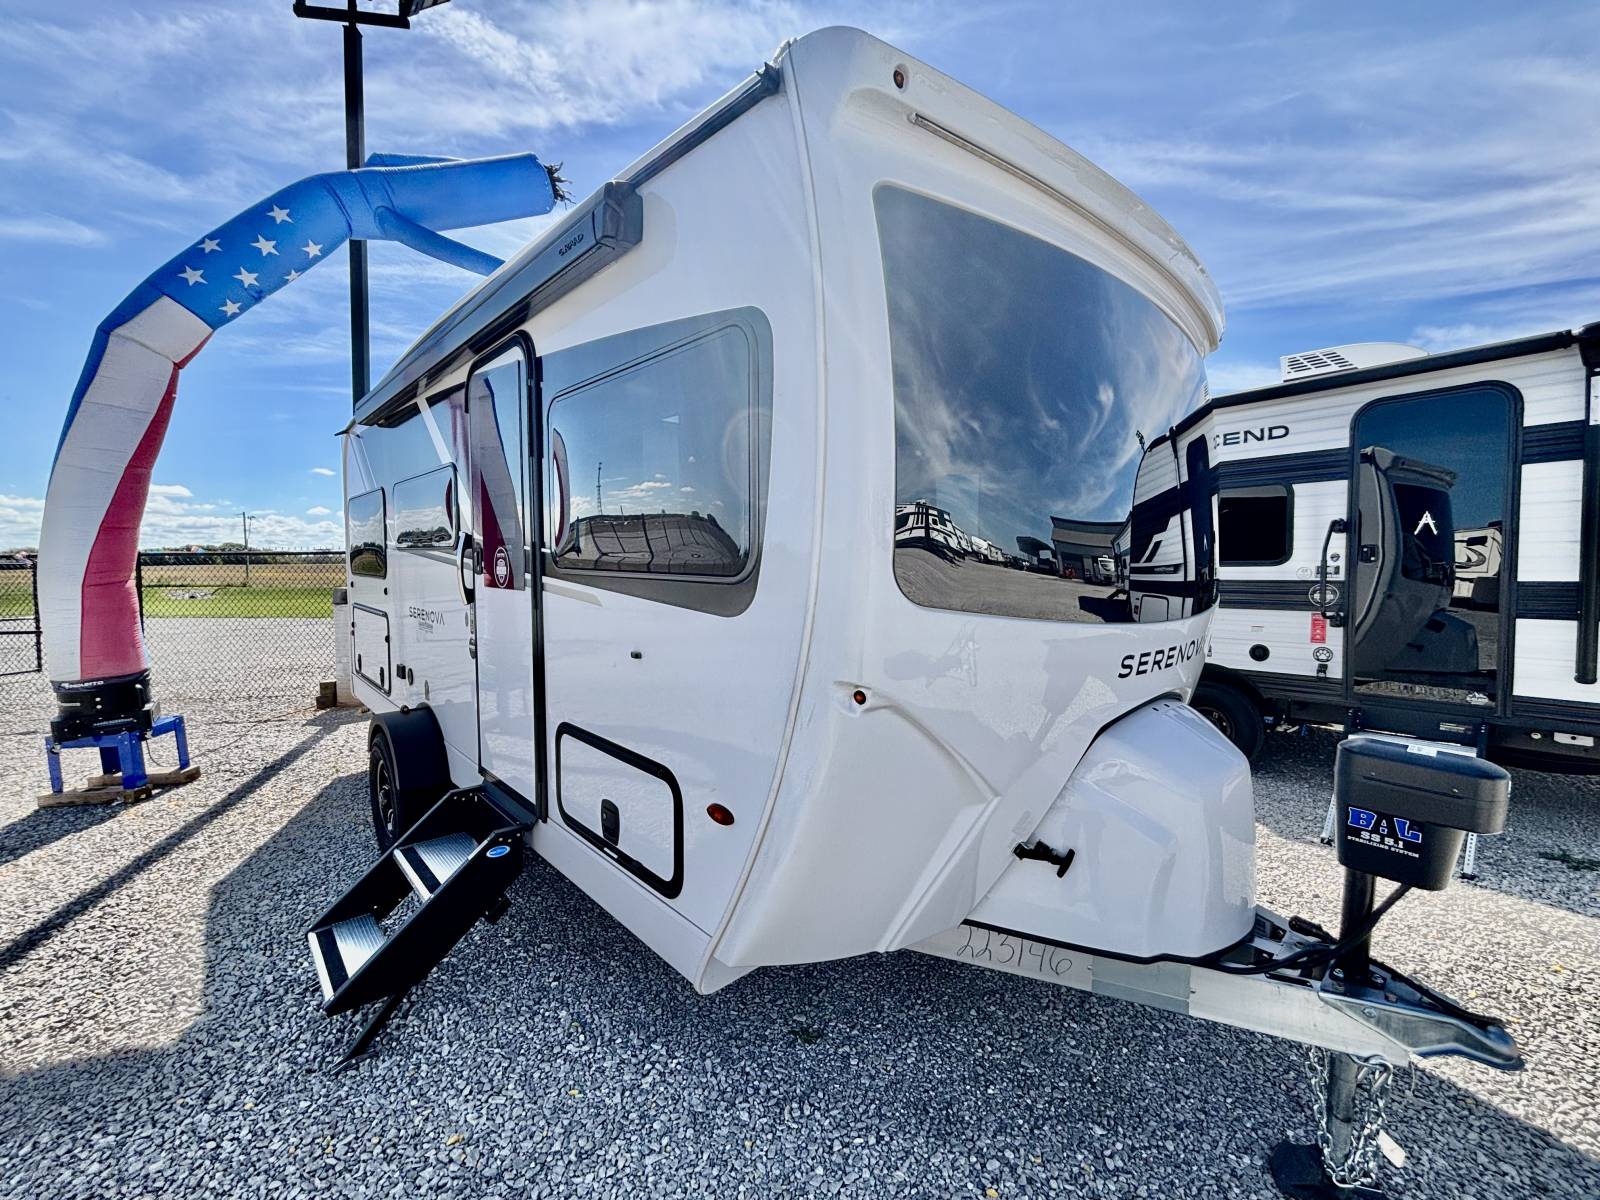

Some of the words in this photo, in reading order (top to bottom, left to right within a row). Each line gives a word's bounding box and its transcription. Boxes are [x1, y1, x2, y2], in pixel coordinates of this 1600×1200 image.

[408, 606, 445, 625] SERENOVA
[1360, 831, 1381, 842] SS
[1384, 837, 1404, 849] 5.1
[1390, 846, 1419, 858] SYSTEM
